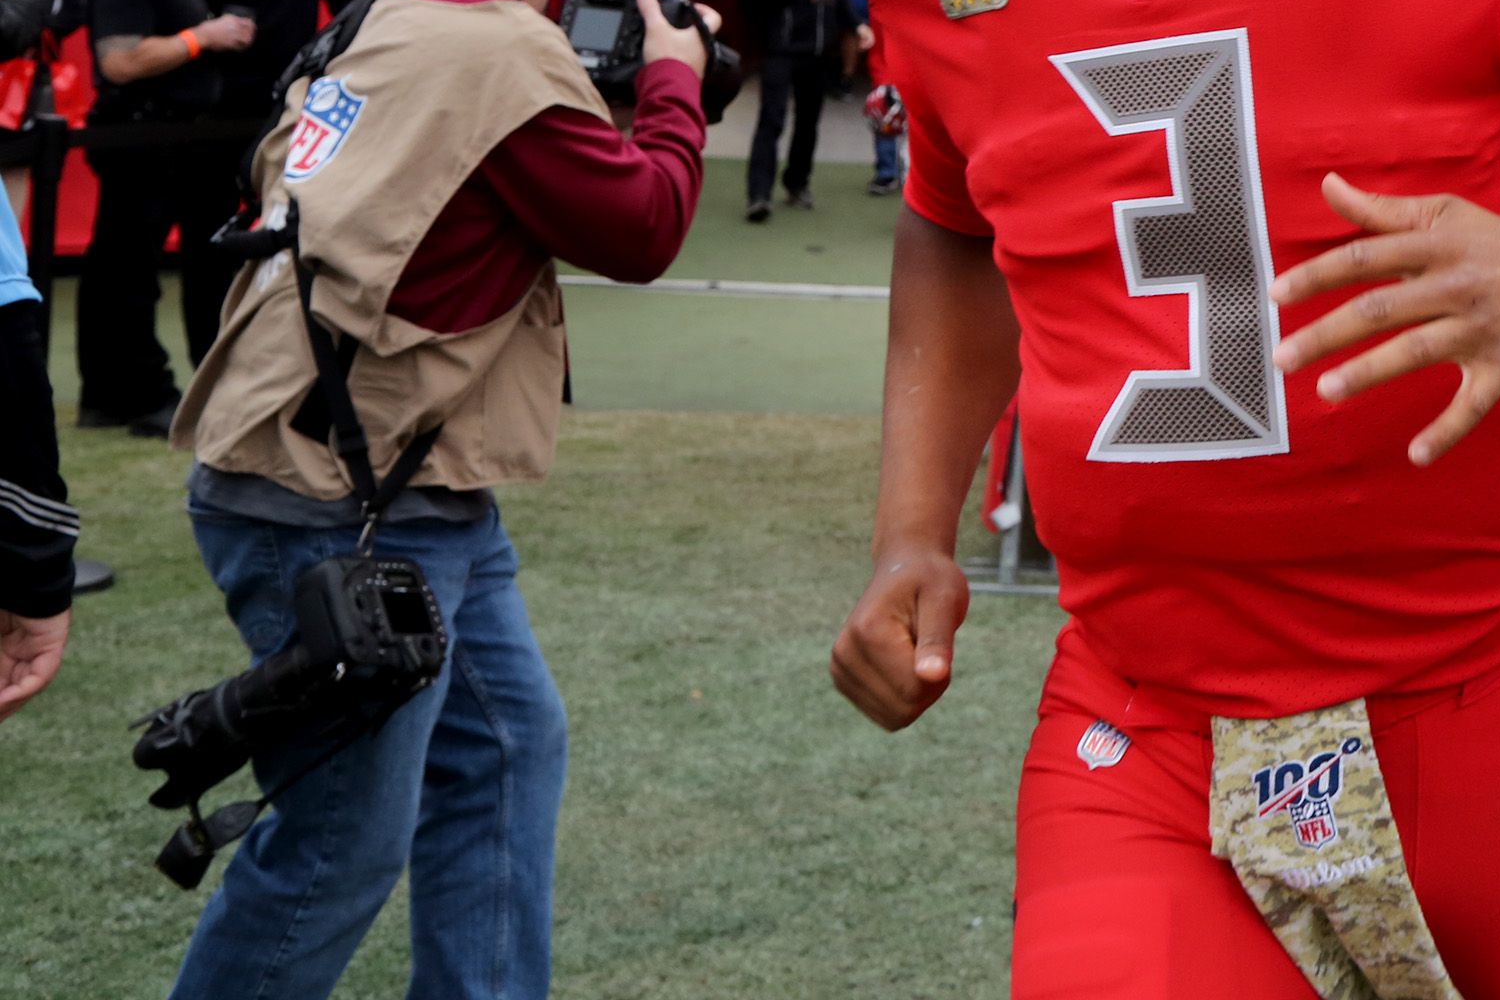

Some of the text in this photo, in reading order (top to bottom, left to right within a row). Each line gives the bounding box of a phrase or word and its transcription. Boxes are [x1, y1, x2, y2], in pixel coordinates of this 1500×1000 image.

[288, 115, 330, 170] FL
[1048, 28, 1289, 463] 3
[1253, 749, 1344, 808] 100
[1298, 817, 1332, 843] NFL
